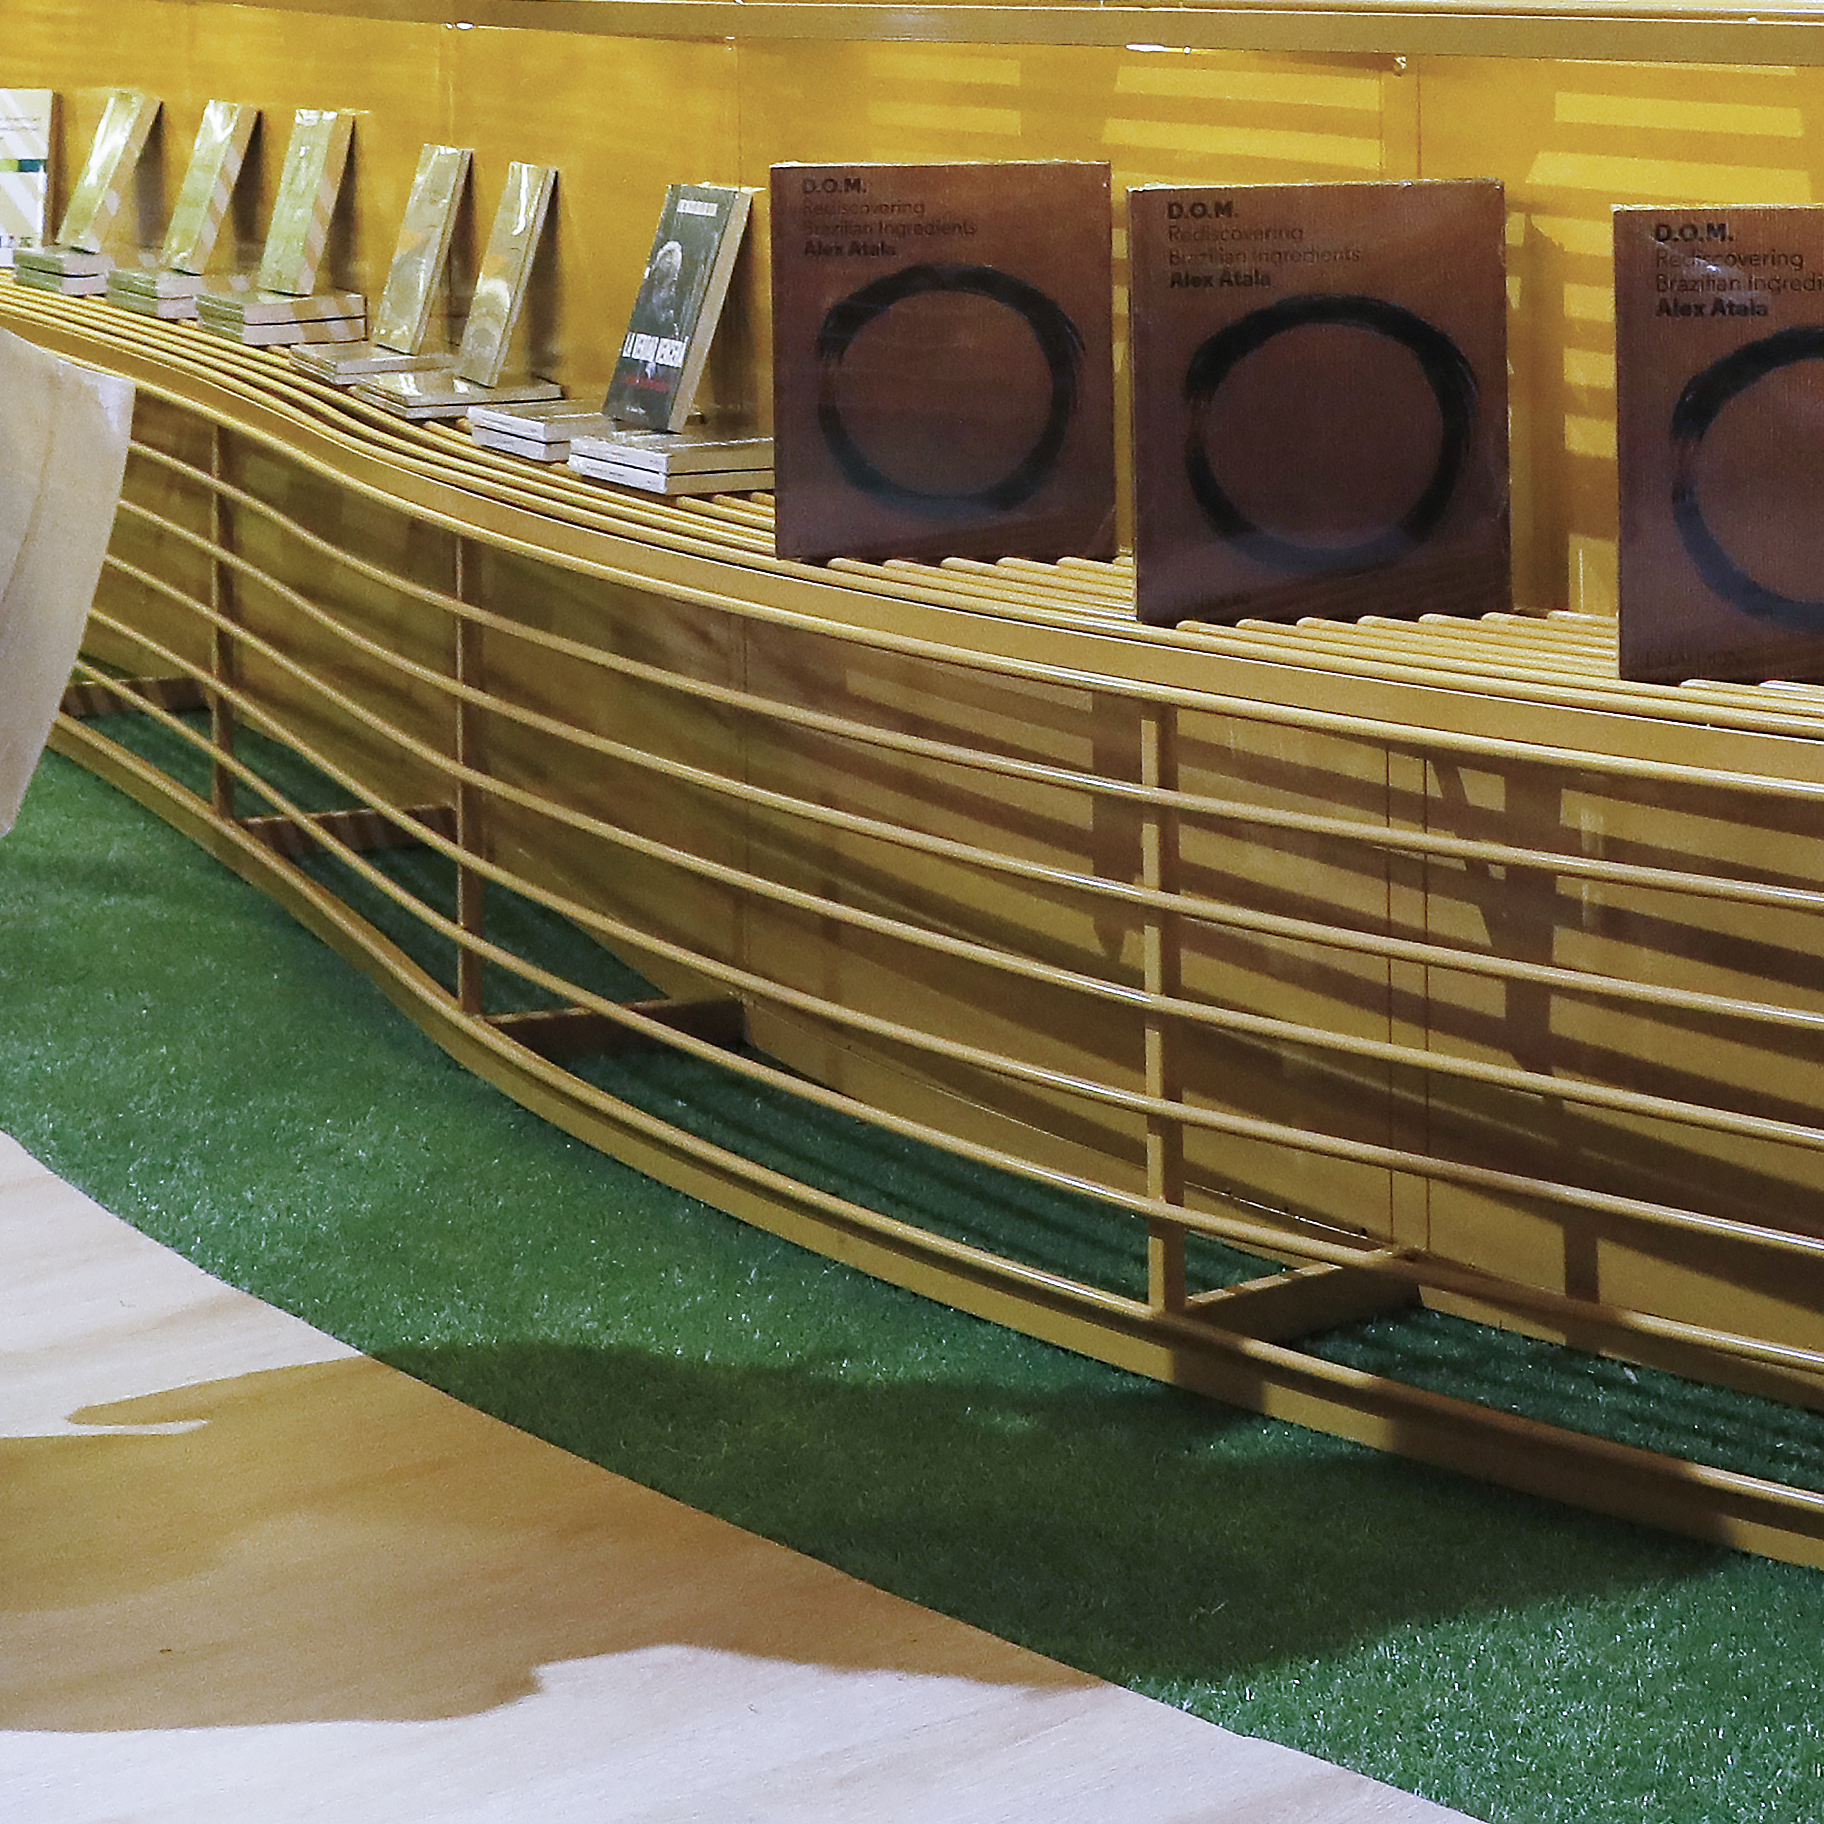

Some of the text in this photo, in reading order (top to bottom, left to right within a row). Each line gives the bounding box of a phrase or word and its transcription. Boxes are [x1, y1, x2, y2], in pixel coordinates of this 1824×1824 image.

[803, 177, 867, 194] D.O.M.
[1168, 201, 1239, 219] D.O.M.
[1654, 223, 1734, 242] D.O.M.
[1170, 271, 1213, 289] Alex
[1657, 273, 1742, 293] Brazilian
[1656, 298, 1769, 318] Alex Atala
